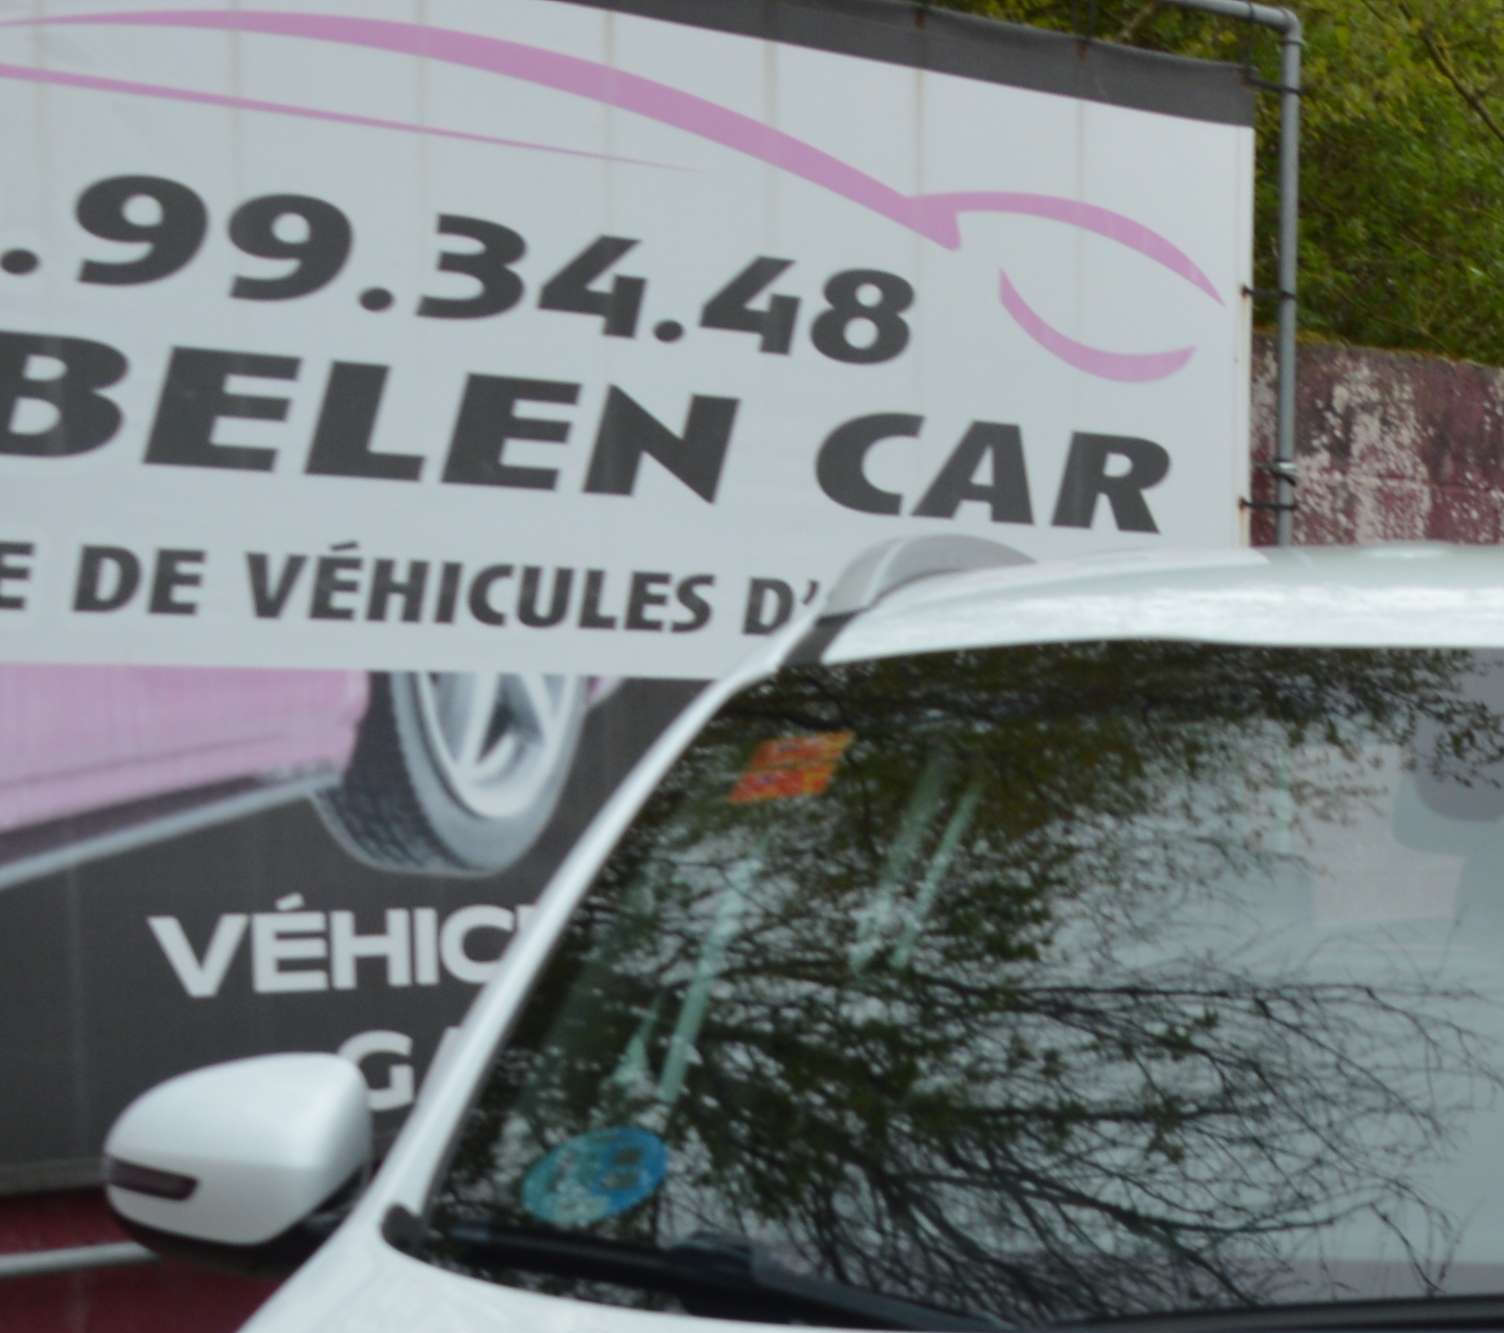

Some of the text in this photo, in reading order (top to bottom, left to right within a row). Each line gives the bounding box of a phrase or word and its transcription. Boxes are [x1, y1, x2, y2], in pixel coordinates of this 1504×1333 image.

[815, 412, 1171, 535] CAR
[72, 546, 206, 616] DE
[246, 540, 716, 635] VÉHICULES
[148, 892, 540, 998] VÉHIC
